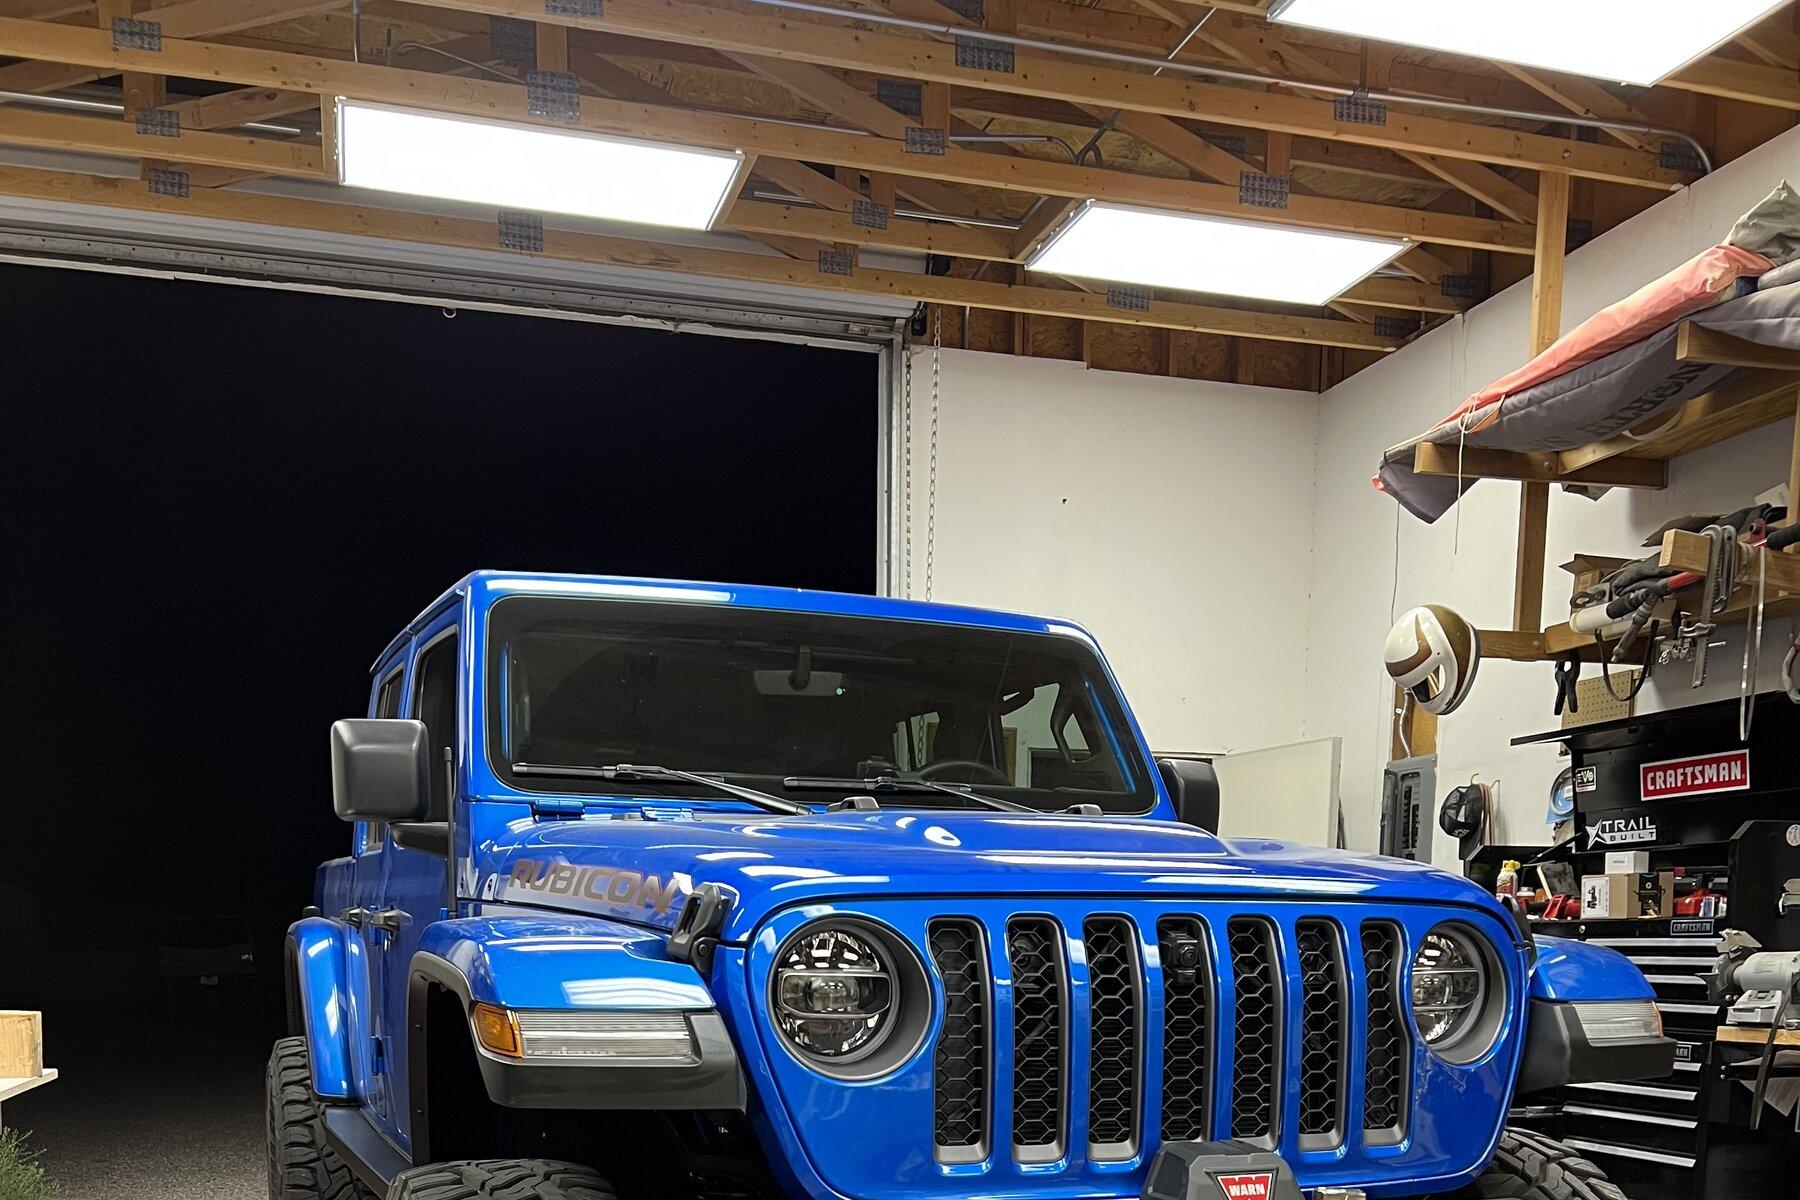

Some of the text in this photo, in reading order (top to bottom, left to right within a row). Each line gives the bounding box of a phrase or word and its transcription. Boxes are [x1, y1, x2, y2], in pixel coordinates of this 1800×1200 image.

[1646, 760, 1742, 791] CRAFTSMAN
[1602, 816, 1656, 833] TRAIL
[1609, 831, 1655, 842] BUILT
[509, 858, 681, 913] RUBICON
[1228, 1183, 1265, 1197] WARN
